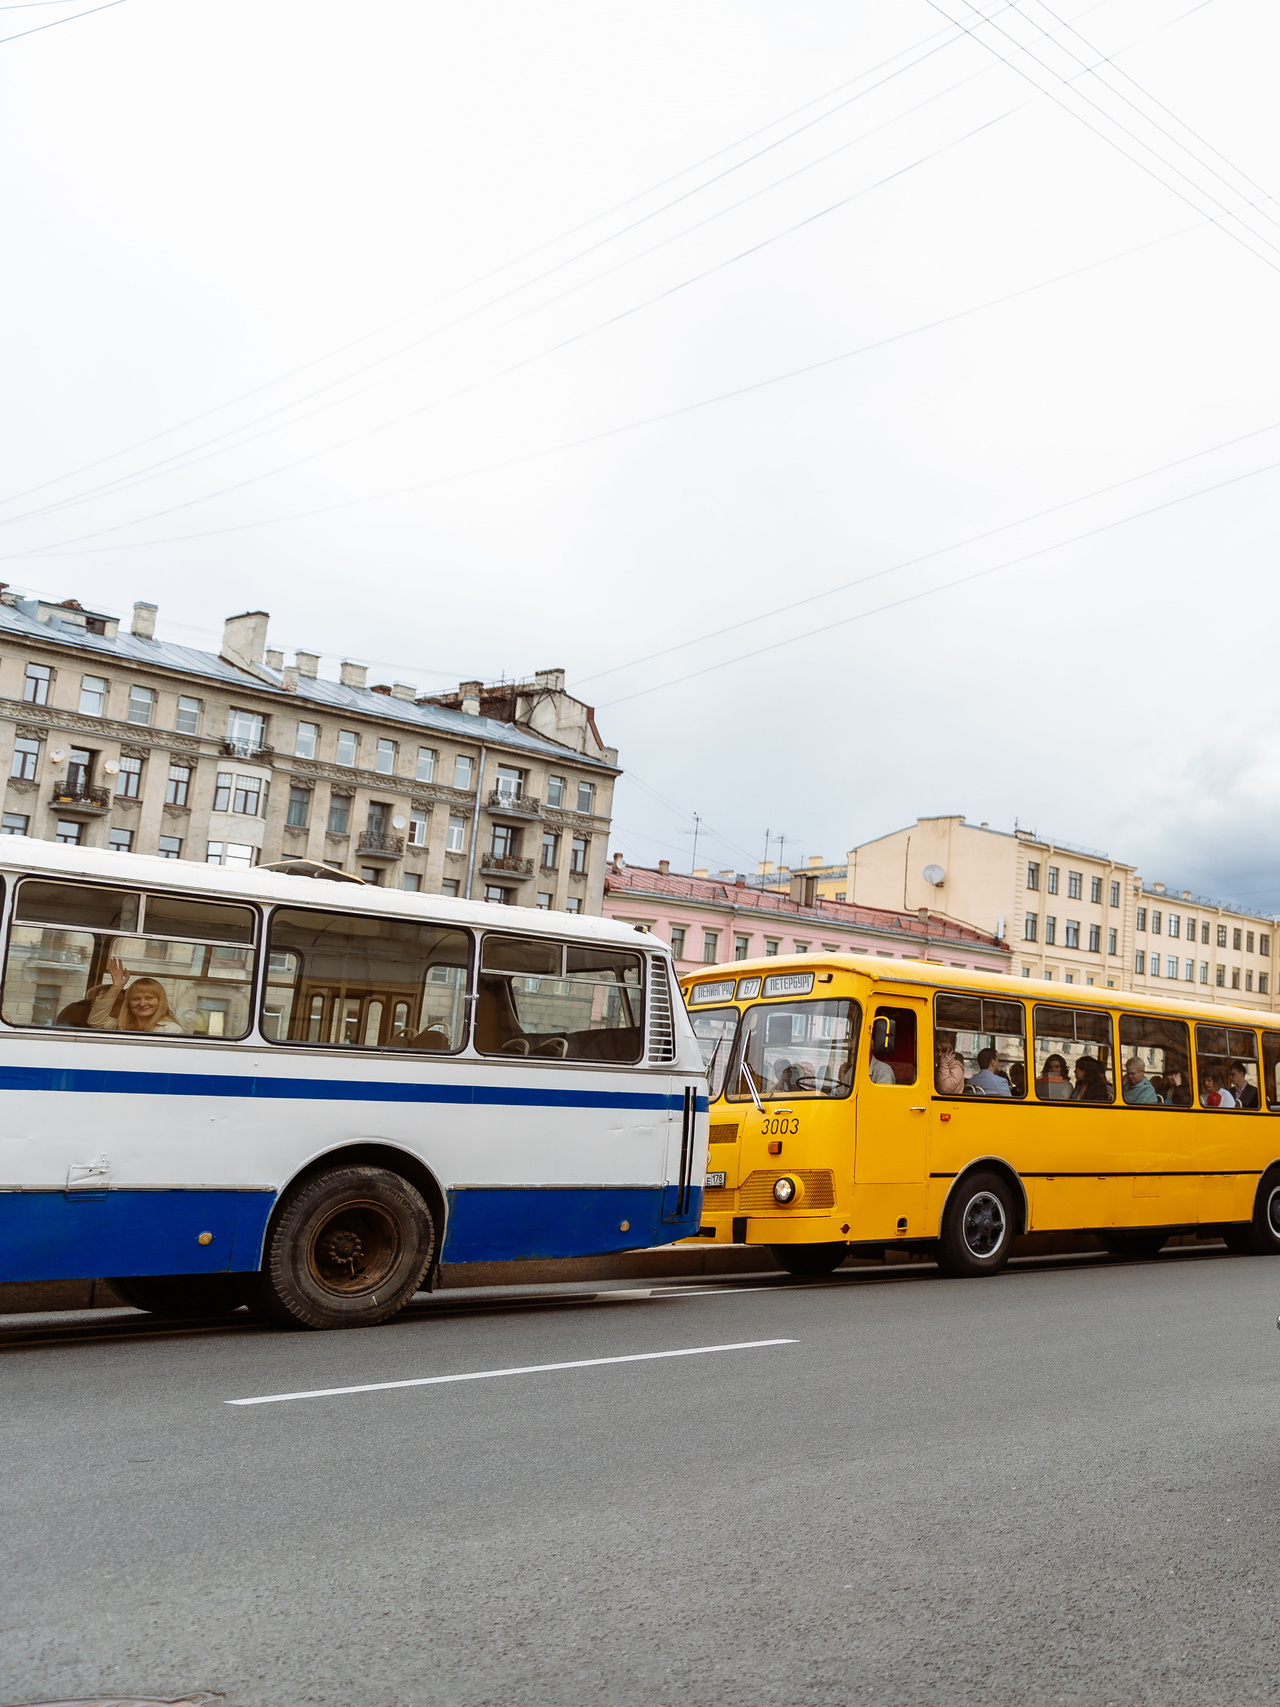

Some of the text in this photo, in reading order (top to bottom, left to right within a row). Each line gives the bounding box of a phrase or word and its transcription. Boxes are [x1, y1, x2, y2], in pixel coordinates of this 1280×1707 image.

[697, 975, 812, 999] ЛЕНИНГРАД 677 ПЕТЕРБУРГ
[761, 1118, 800, 1135] 3003
